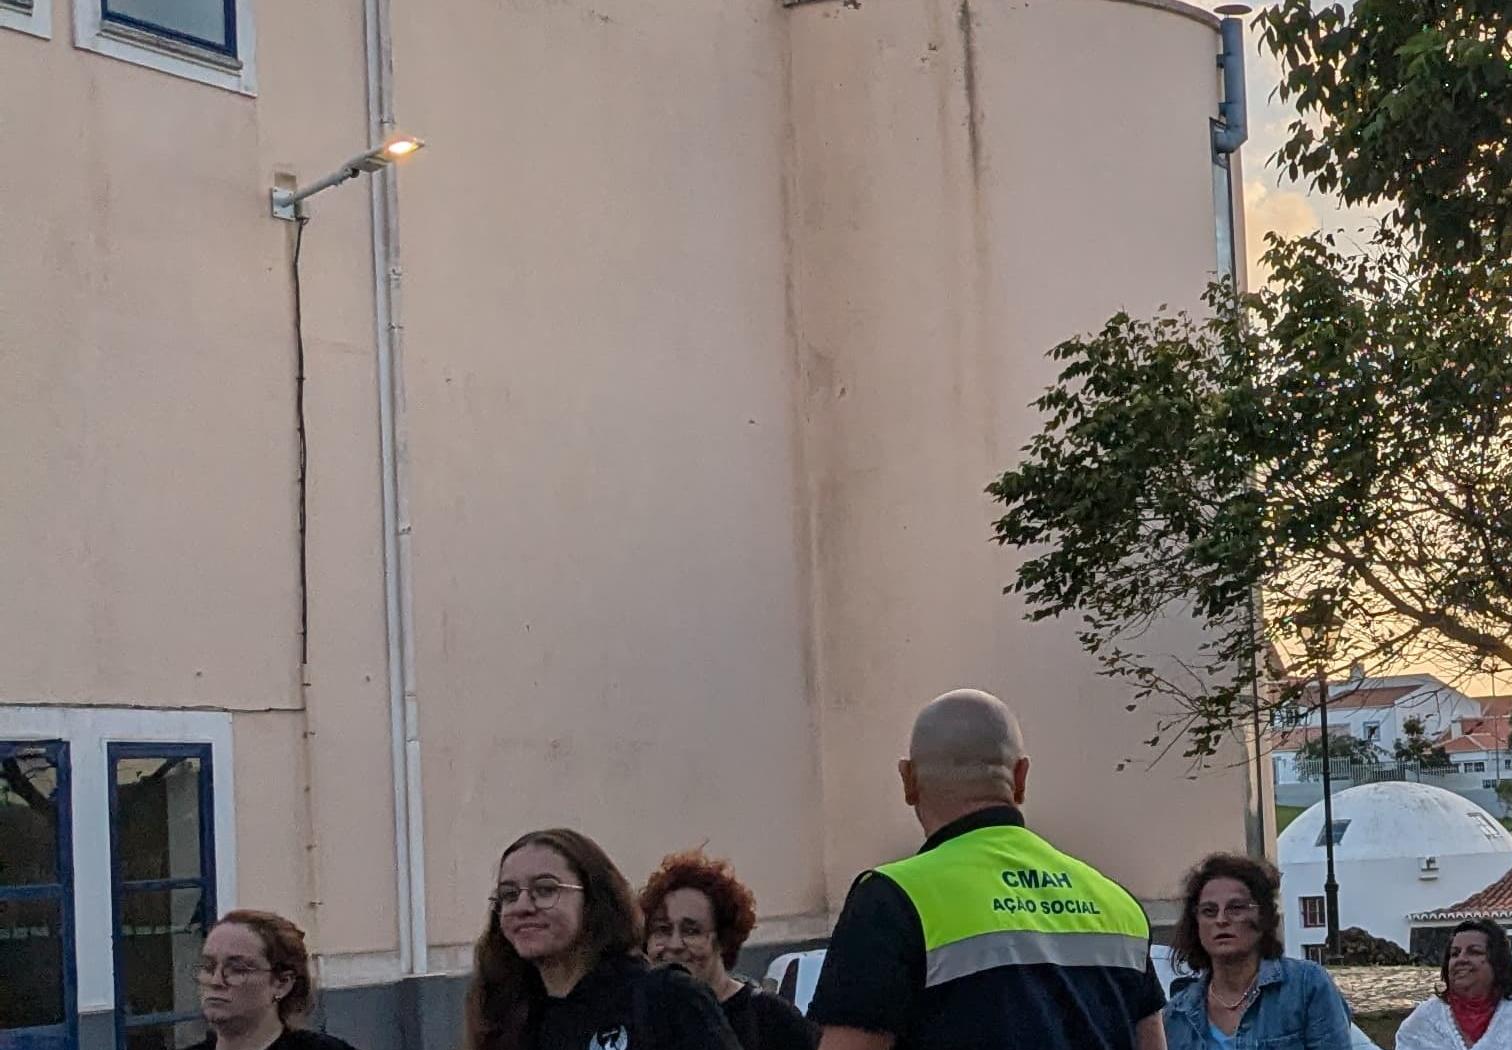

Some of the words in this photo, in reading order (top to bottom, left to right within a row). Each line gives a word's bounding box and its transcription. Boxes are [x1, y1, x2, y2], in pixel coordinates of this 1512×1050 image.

[1001, 868, 1073, 889] CMAH
[993, 896, 1037, 914] AÇÃO
[1040, 900, 1101, 915] SOCIAL
